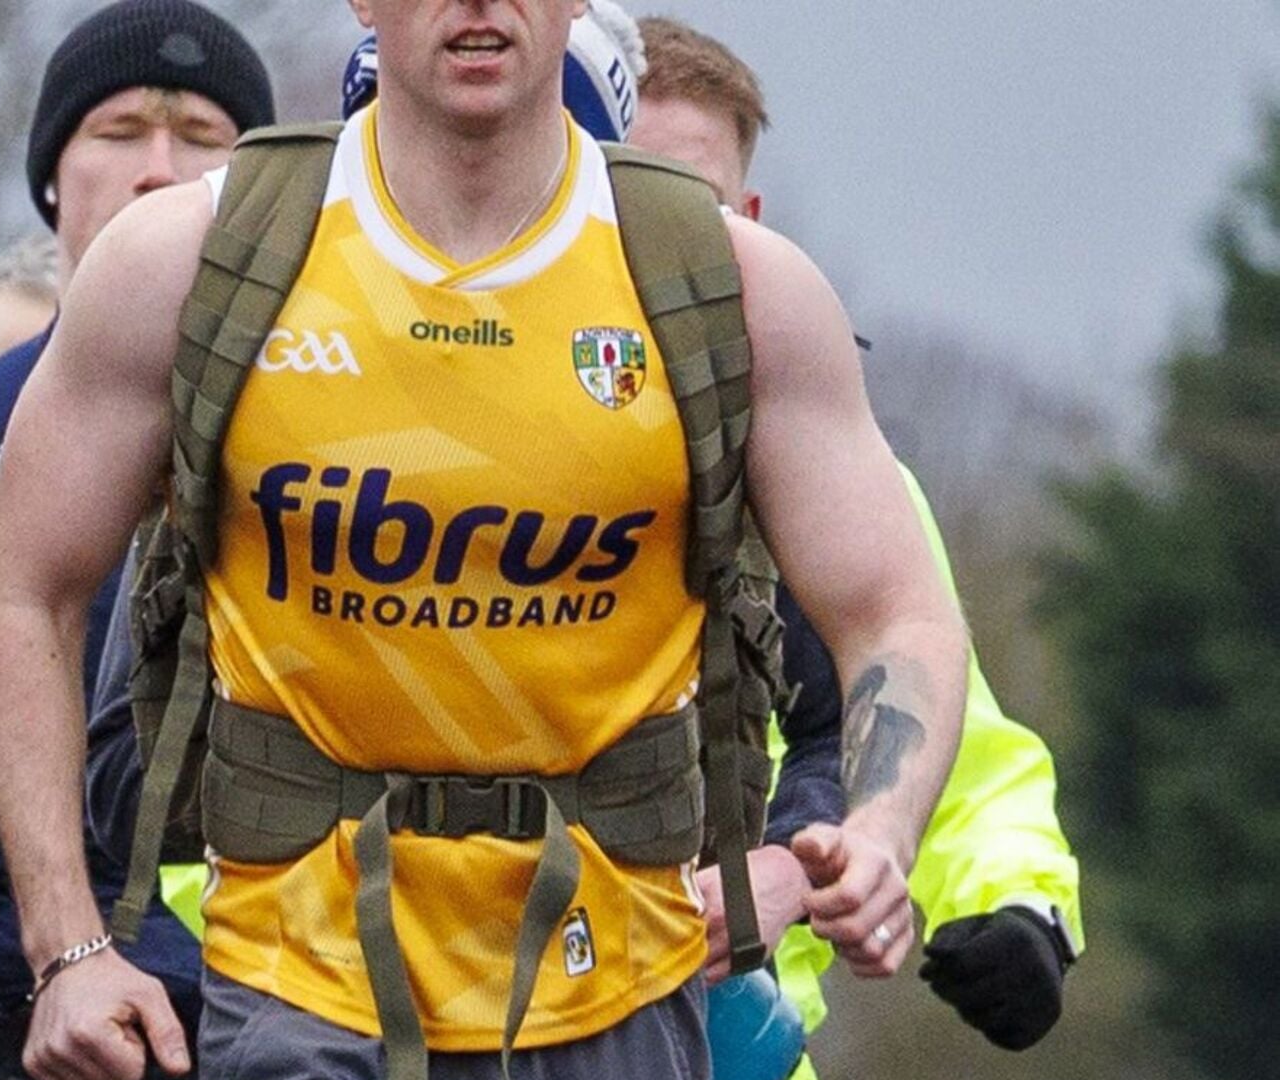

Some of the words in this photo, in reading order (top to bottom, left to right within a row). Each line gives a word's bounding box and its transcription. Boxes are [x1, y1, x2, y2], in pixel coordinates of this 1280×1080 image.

[409, 319, 514, 347] o'neills
[251, 462, 657, 602] fibrus
[311, 586, 618, 630] BROADBAND
